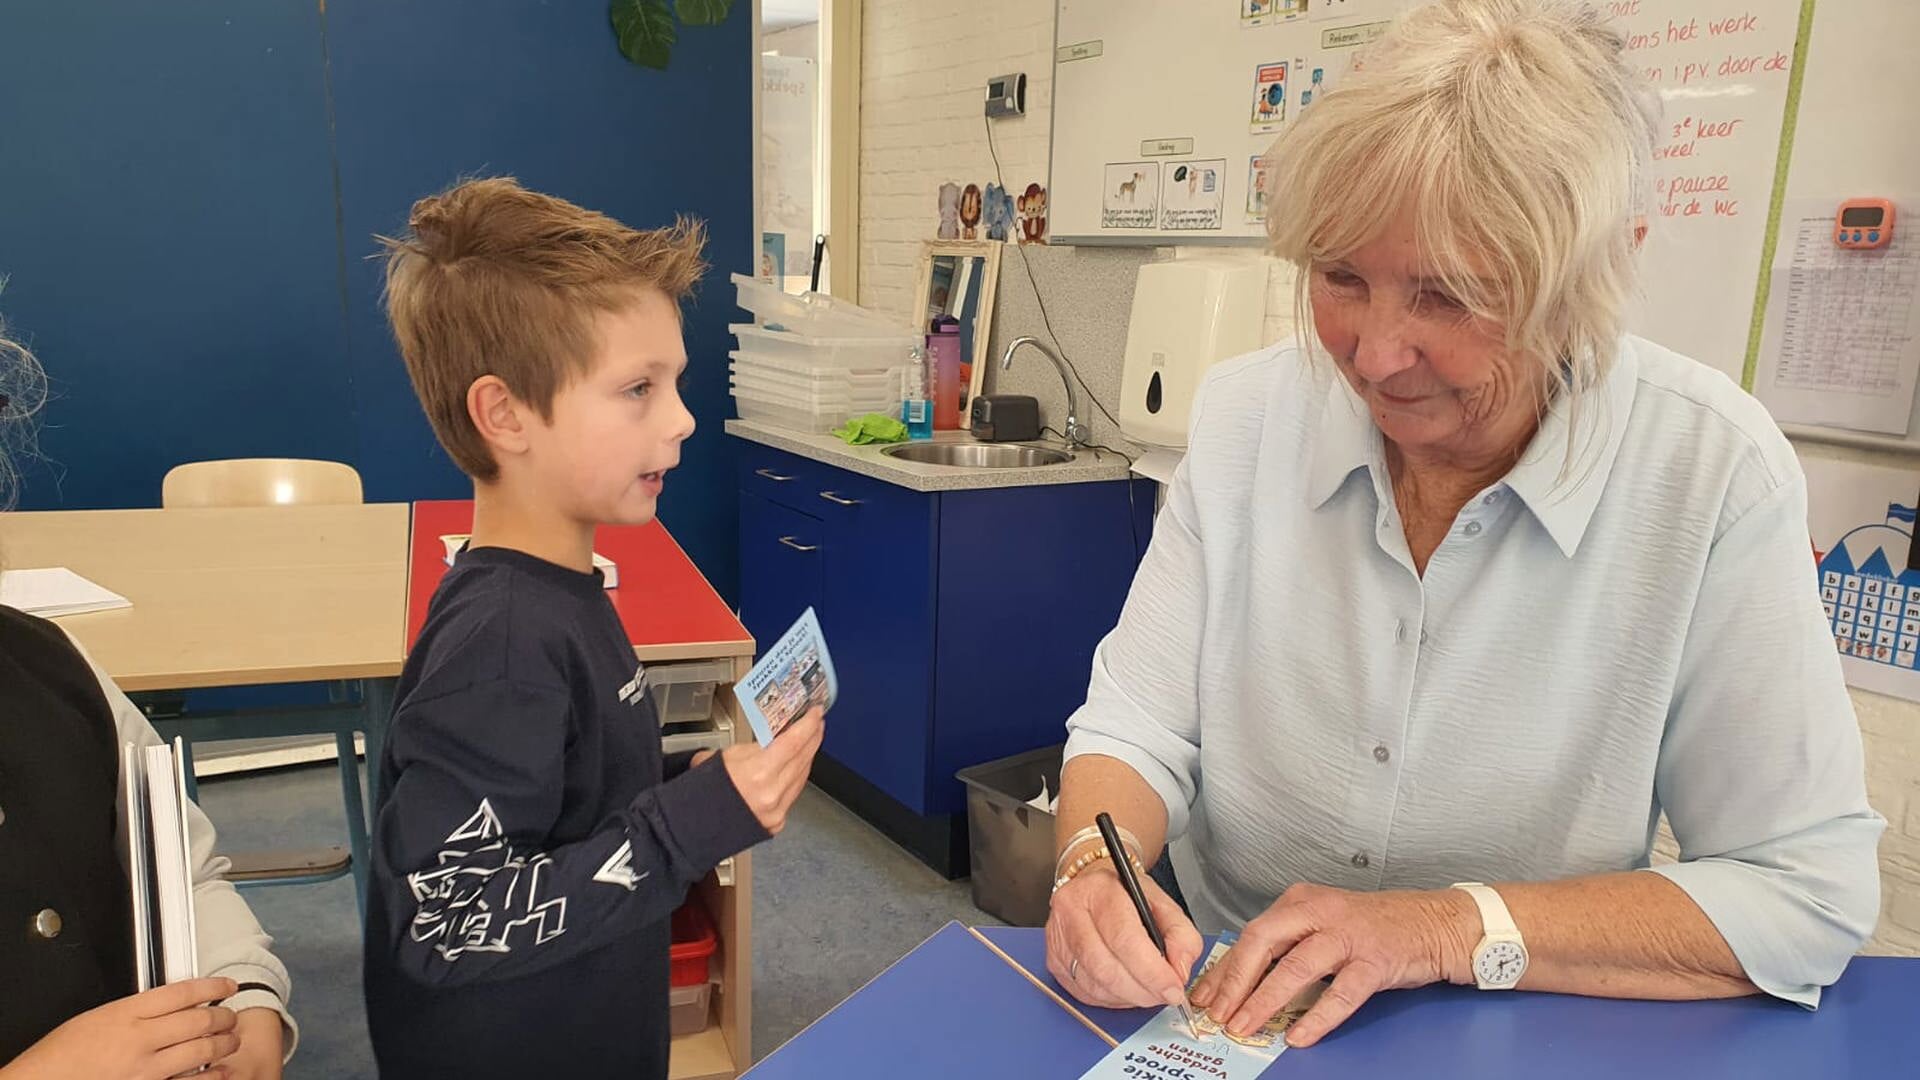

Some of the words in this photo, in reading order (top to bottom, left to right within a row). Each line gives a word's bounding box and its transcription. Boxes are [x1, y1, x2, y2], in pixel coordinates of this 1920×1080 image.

[1667, 17, 1698, 43] het
[1709, 11, 1757, 35] werk
[1718, 55, 1763, 76] door
[1763, 51, 1788, 71] de
[1697, 119, 1744, 139] keer
[1668, 175, 1729, 203] pauze
[1683, 198, 1702, 217] de
[1124, 1052, 1195, 1080] Sproet
[1147, 1043, 1228, 1079] Verdachte
[1169, 1043, 1225, 1066] gasten
